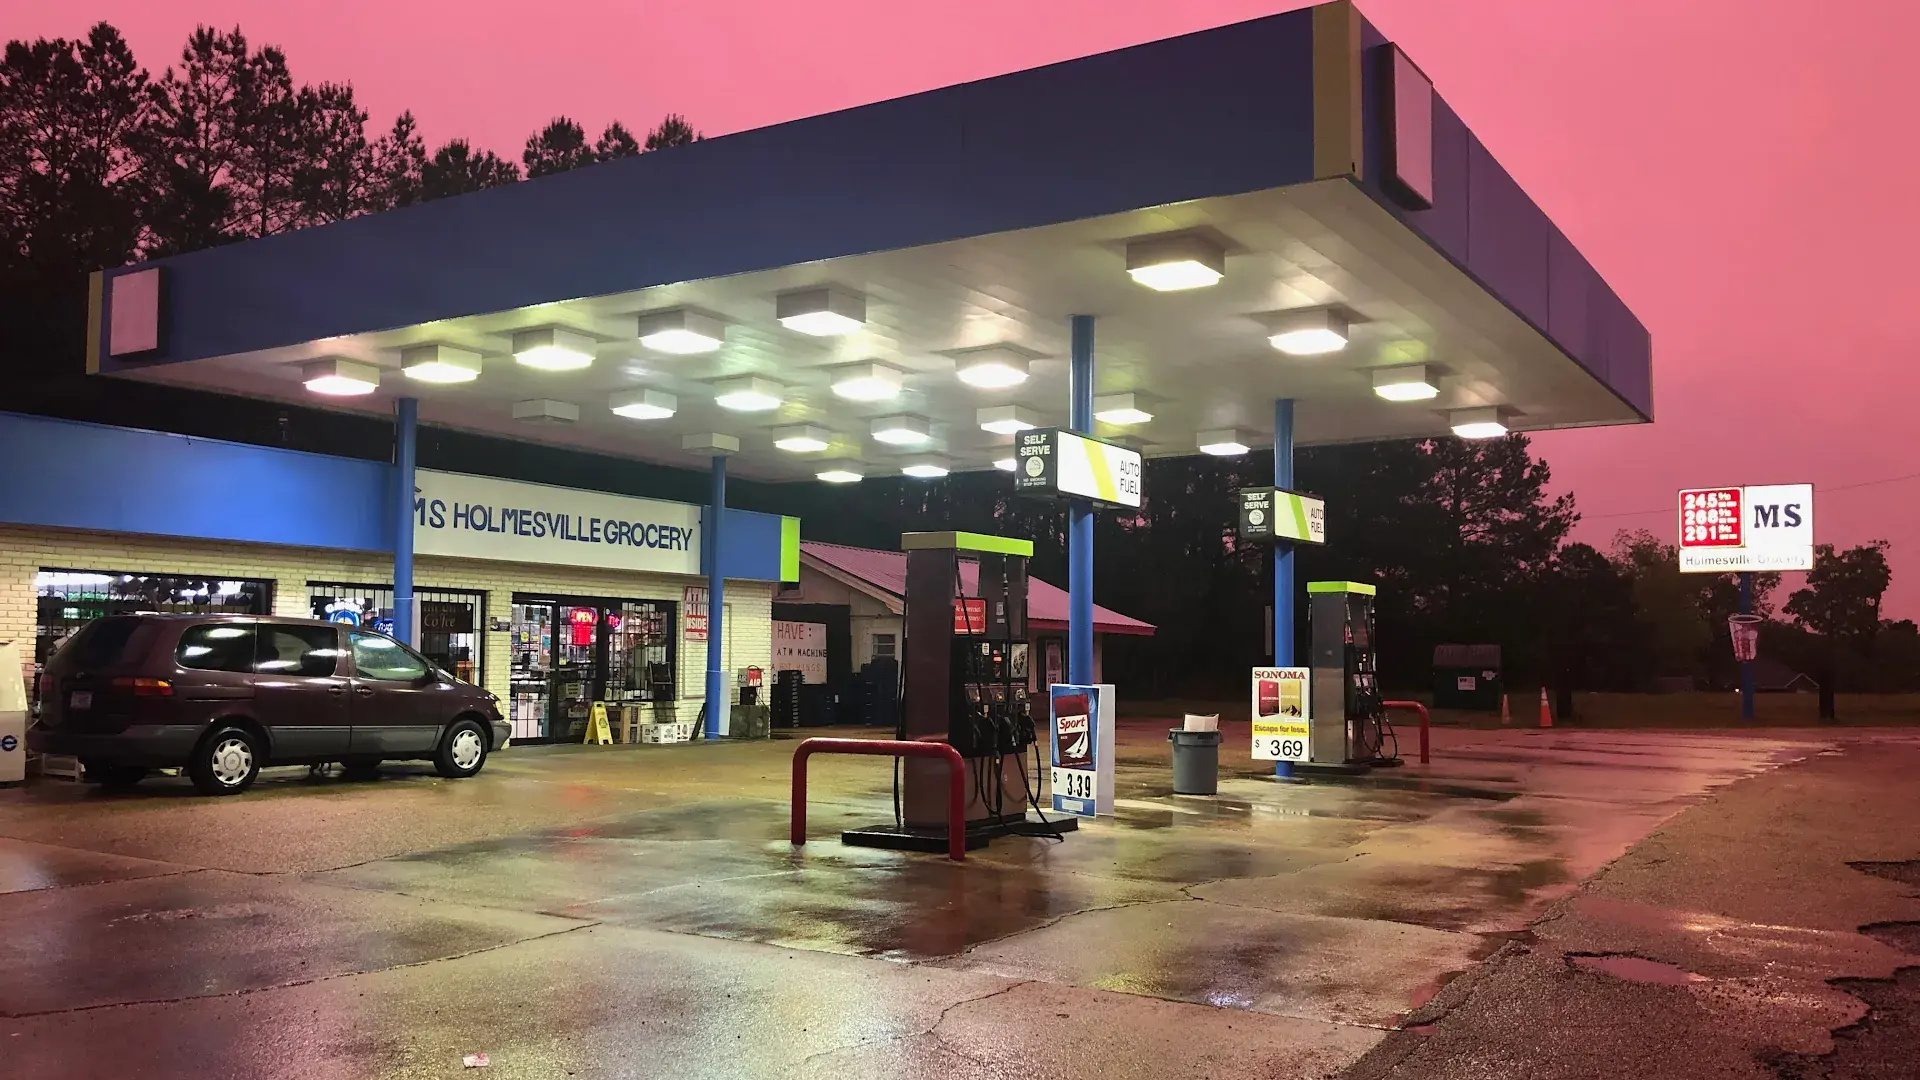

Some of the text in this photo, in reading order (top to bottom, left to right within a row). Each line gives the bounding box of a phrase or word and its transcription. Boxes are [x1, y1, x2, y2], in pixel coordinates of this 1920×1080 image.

[1024, 434, 1046, 444] SELF
[1020, 445, 1050, 456] SERVE
[1120, 460, 1139, 477] AUTO
[1120, 478, 1138, 494] FUEL
[1247, 493, 1266, 501] SELF
[1684, 493, 1718, 509] 245
[1244, 501, 1269, 509] SERVE
[1311, 508, 1323, 520] AUTO
[1754, 503, 1802, 528] MS
[453, 502, 601, 543] HOLMESVILLE
[603, 519, 693, 551] GROCERY
[1311, 521, 1323, 533] FUEL
[777, 624, 804, 639] HAVE
[777, 647, 827, 658] ATM MACHINE
[1254, 671, 1306, 679] SONOMA
[749, 678, 761, 686] AIR
[1059, 717, 1086, 732] Sport
[1254, 725, 1279, 733] Escape
[1291, 725, 1307, 733] less.
[1067, 773, 1091, 798] 3.39
